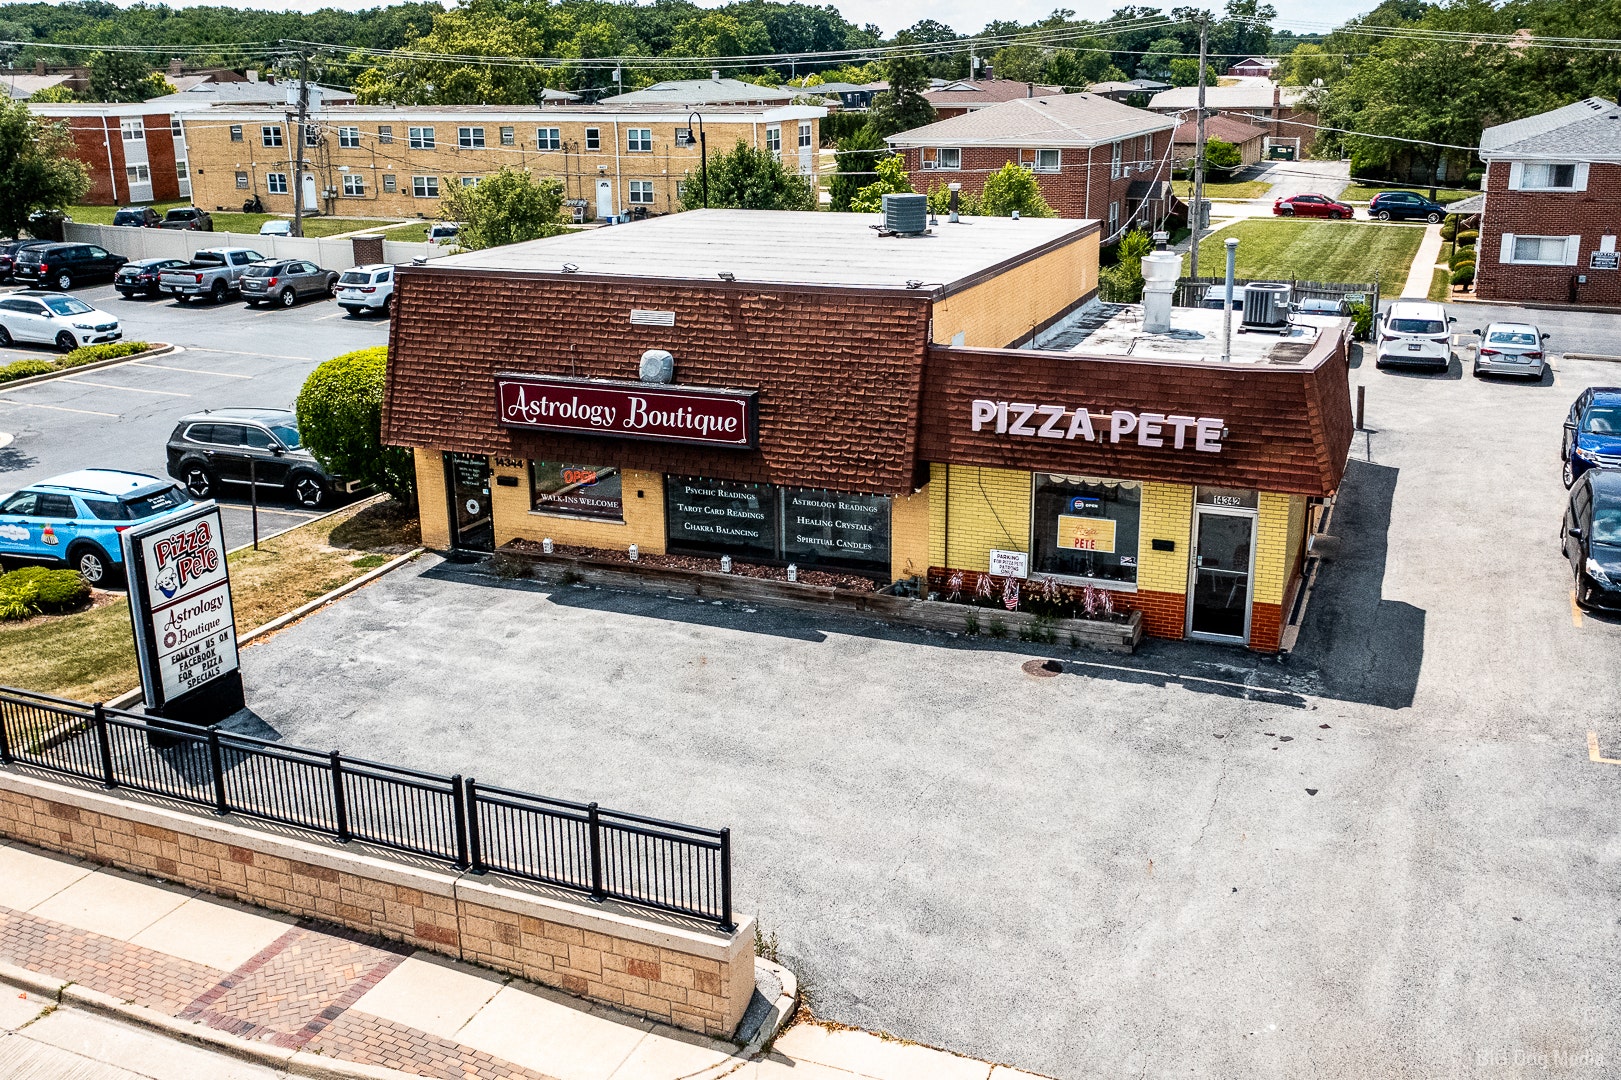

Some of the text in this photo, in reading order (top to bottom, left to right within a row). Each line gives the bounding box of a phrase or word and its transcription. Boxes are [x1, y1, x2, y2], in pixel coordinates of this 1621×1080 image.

[508, 385, 738, 435] Astrology Boutique
[971, 399, 1225, 452] PIZZA PETE
[495, 457, 523, 468] 14344
[564, 470, 596, 484] OPEN
[541, 493, 620, 508] WALK-INS WELCOME
[685, 486, 756, 500] PSYCHIC READINGS
[1214, 495, 1241, 506] 14342
[677, 503, 765, 520] TAROT CARD READINGS
[792, 497, 878, 513] ASTROLOGY READINGS
[684, 522, 759, 538] CHAKRA BALANCING
[797, 516, 873, 532] HEALING CRYSTALS
[153, 521, 212, 572] Pizza
[796, 534, 872, 550] SPIRITUAL CANDLES
[1074, 537, 1096, 549] PETE
[996, 553, 1020, 561] PARKING
[164, 593, 224, 631] Astrology
[178, 619, 220, 645] Boutique
[171, 631, 229, 665] FOLLOW US ON
[179, 647, 216, 672] FACEBOOK
[178, 655, 223, 683] FOR PIZZA
[187, 666, 220, 689] SPECIALS
